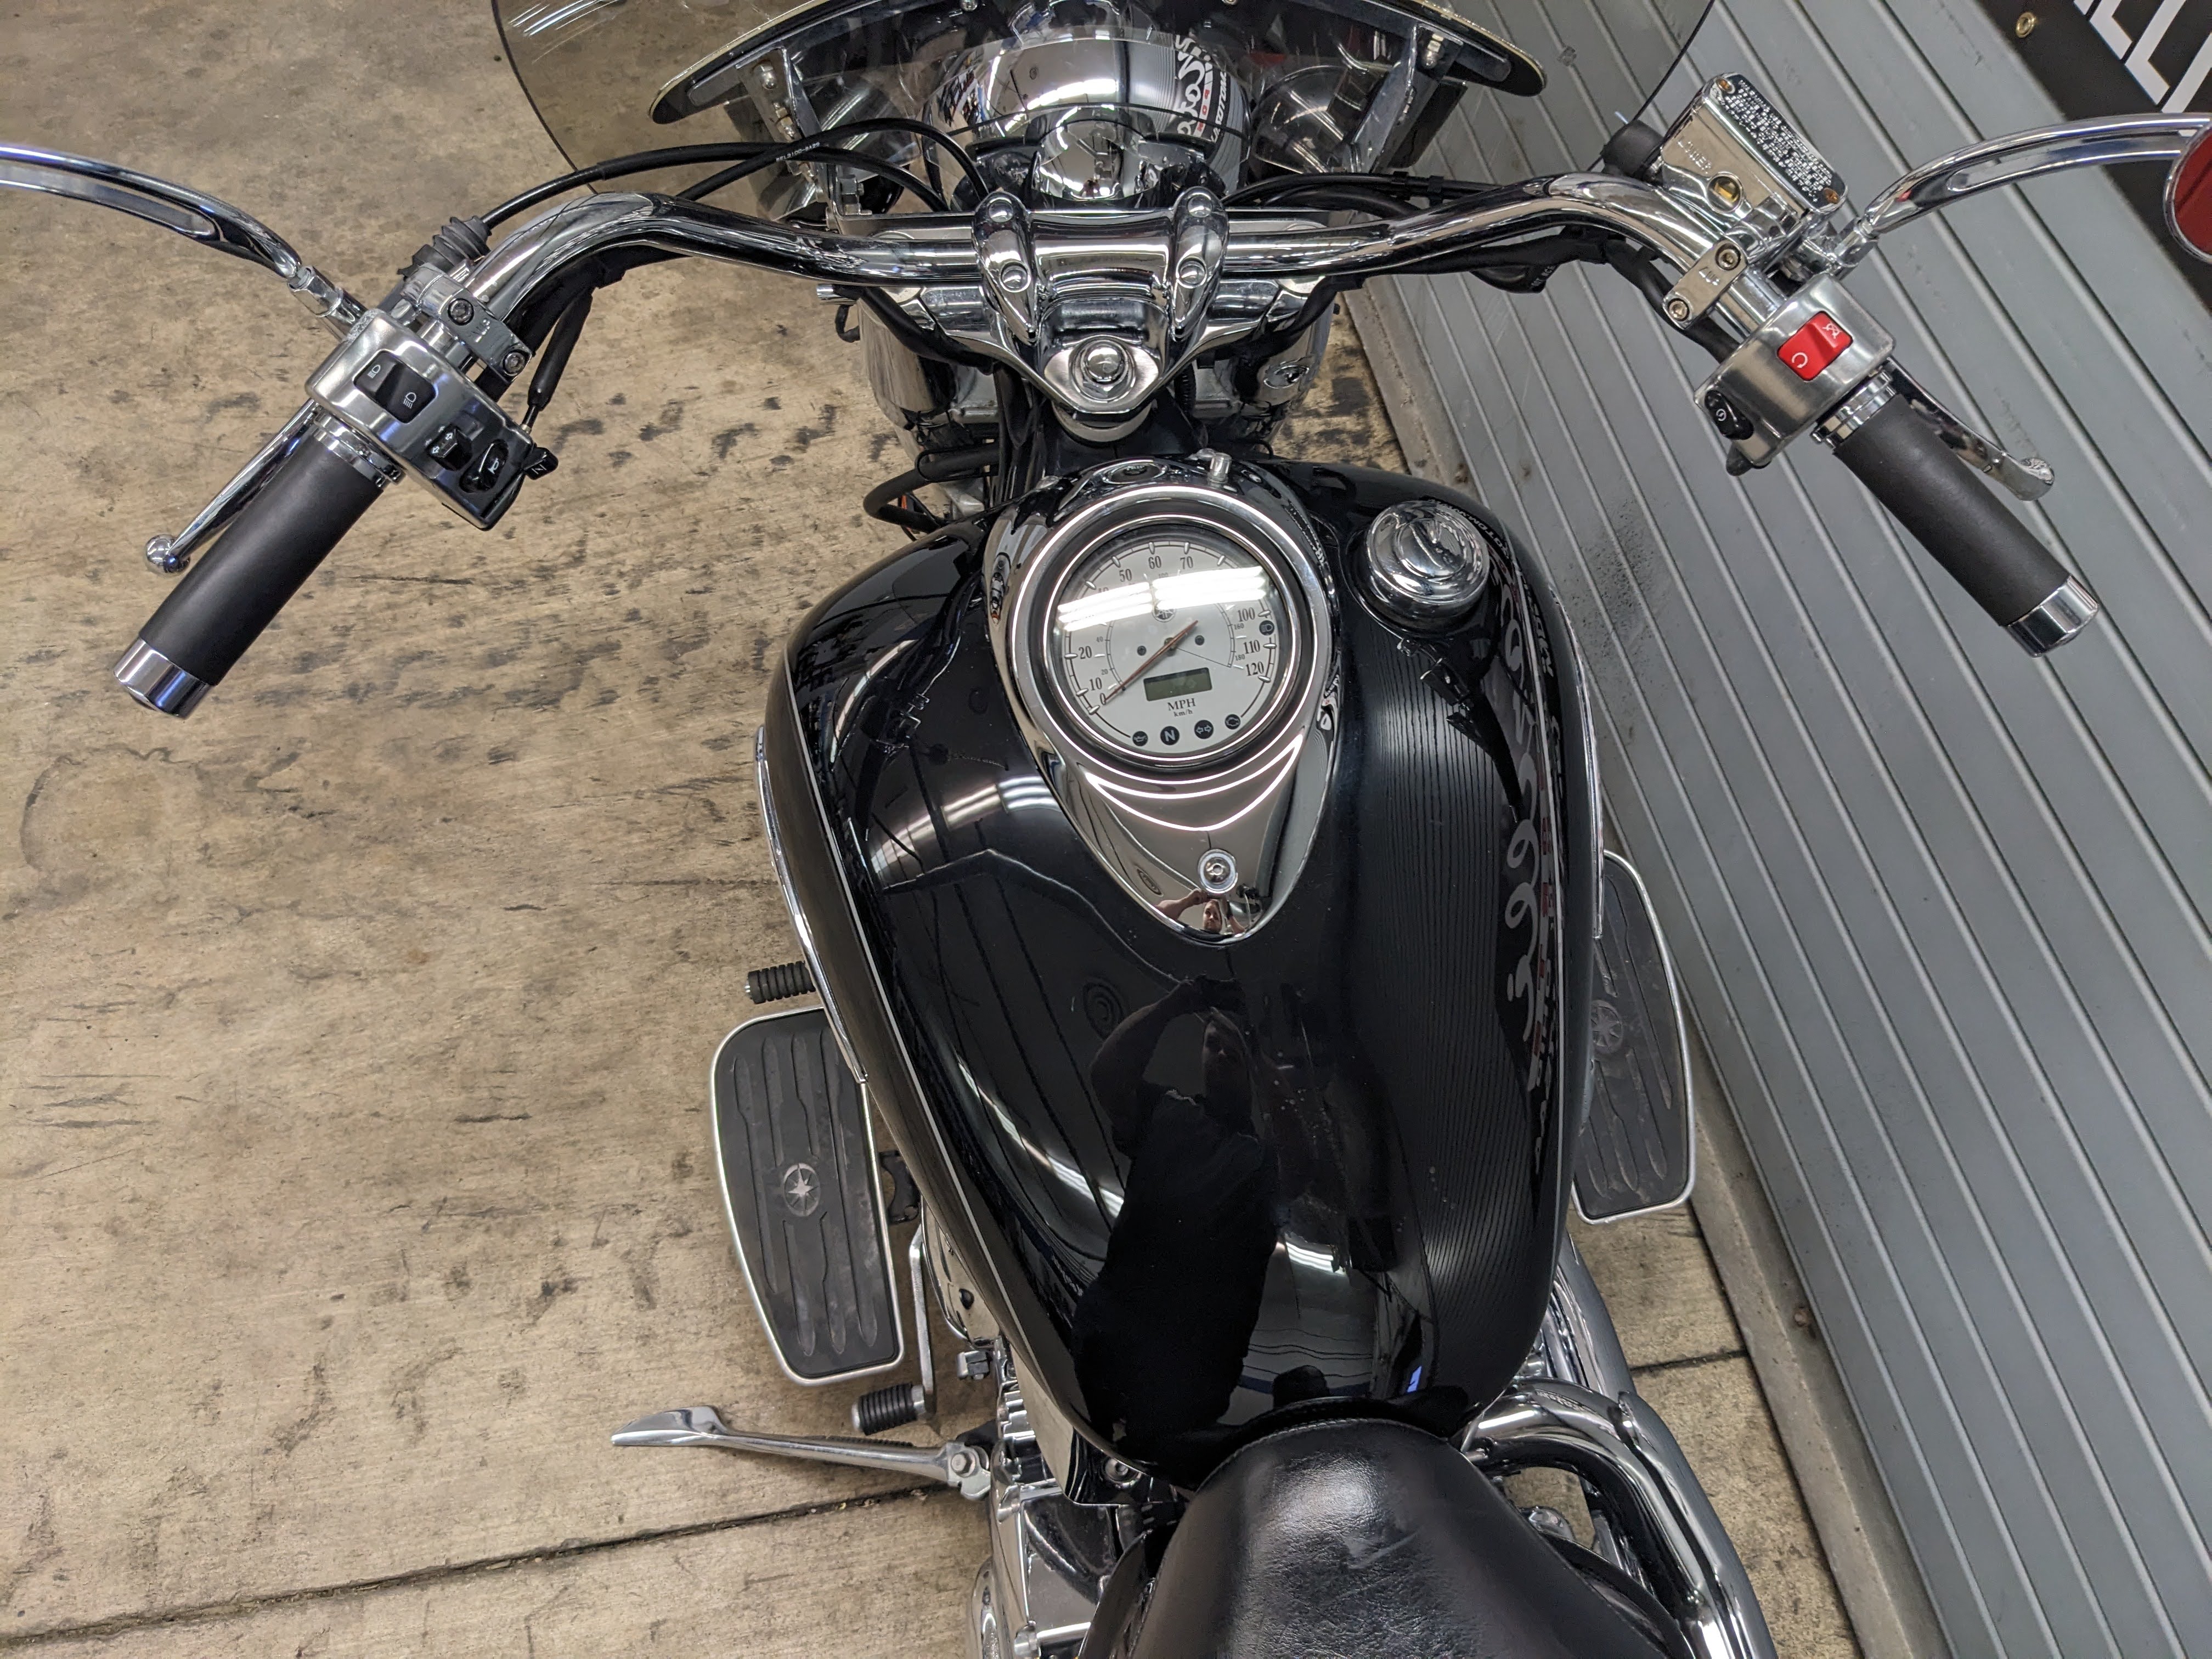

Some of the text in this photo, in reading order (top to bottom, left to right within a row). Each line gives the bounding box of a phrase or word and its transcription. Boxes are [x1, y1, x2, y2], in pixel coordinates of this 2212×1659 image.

[1148, 556, 1161, 569] 60
[1180, 556, 1193, 569] 70
[1119, 569, 1132, 582] 50
[1238, 607, 1255, 622] 100
[1079, 646, 1092, 659] 20
[1243, 640, 1260, 654] 110
[1246, 661, 1264, 676] 120
[1089, 677, 1102, 691] 10
[1099, 693, 1107, 706] 0
[1167, 698, 1196, 711] MPH
[1173, 709, 1193, 717] km/h
[1164, 730, 1176, 742] N
